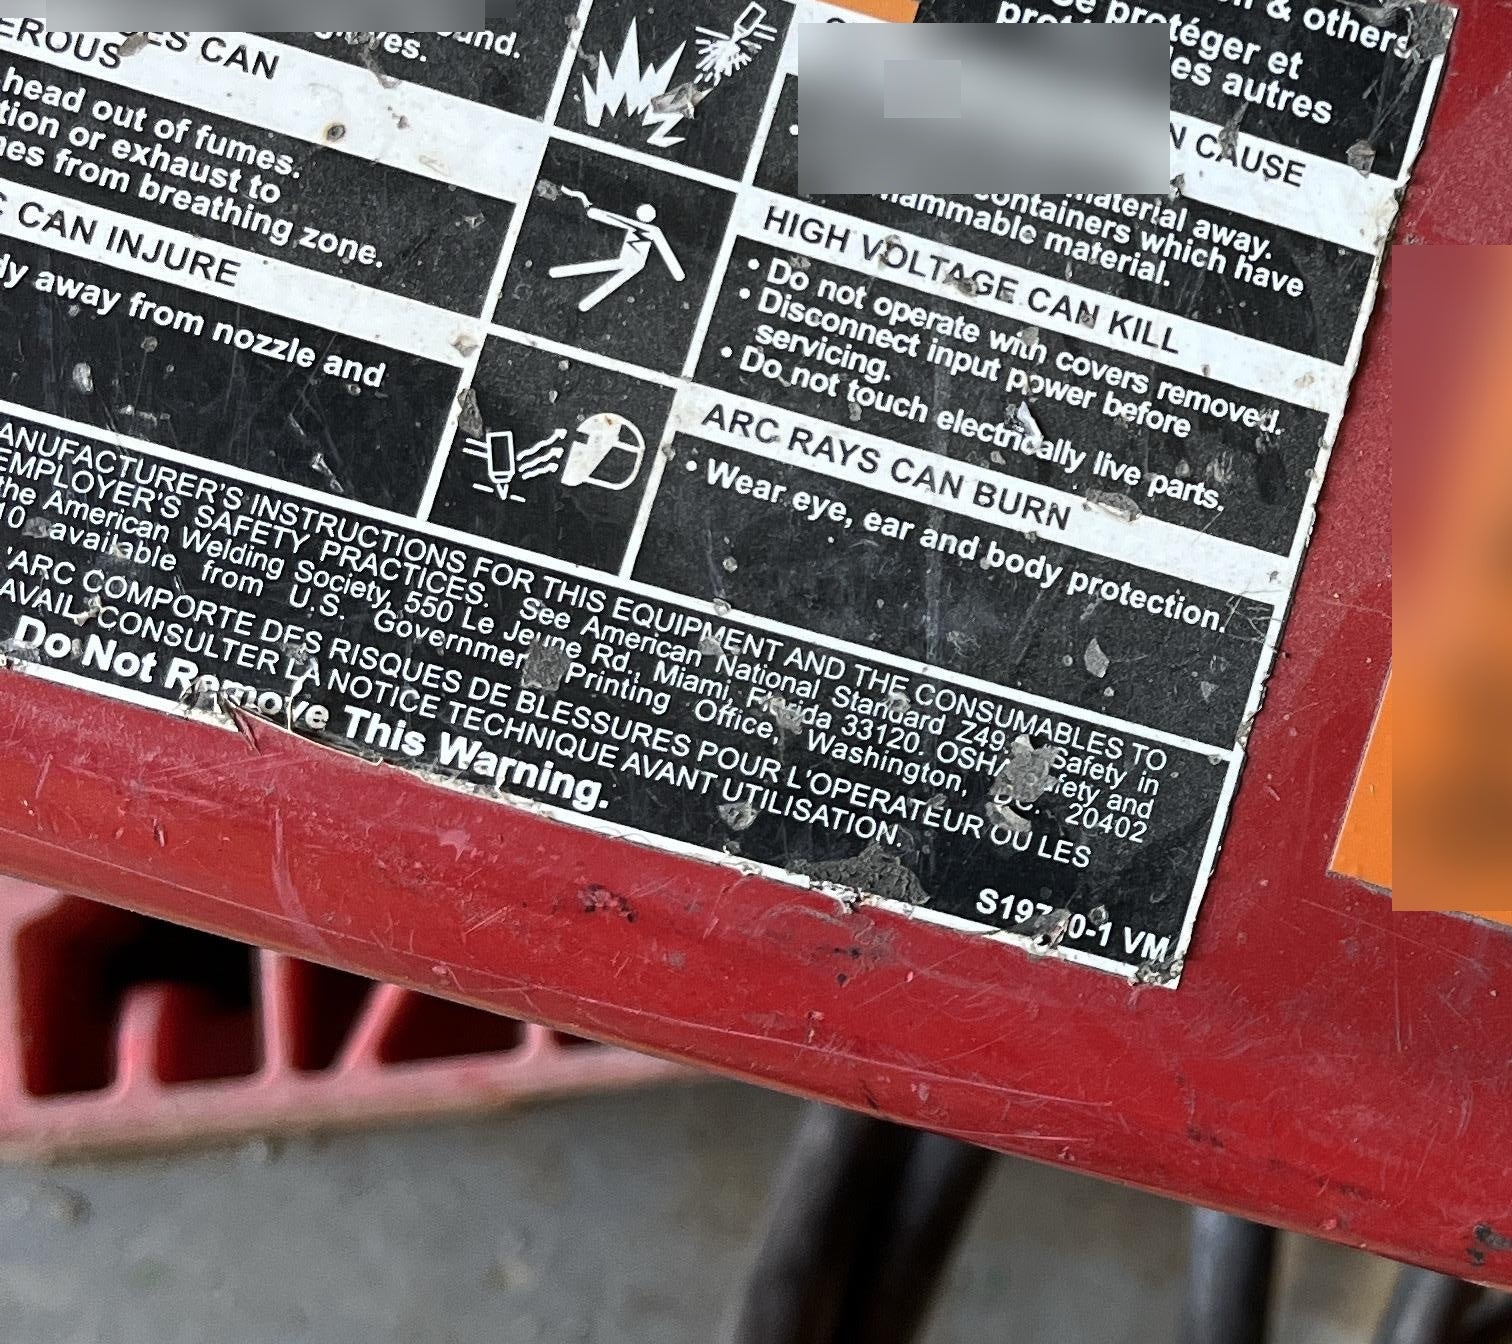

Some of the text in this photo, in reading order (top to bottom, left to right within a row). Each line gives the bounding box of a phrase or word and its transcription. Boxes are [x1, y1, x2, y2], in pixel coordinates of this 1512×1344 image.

[200, 36, 280, 80] CAN
[1221, 72, 1333, 125] autres
[1267, 51, 1304, 80] et
[1, 66, 302, 179] head out of fumes.
[68, 125, 281, 204] or exhaust to
[1195, 133, 1306, 188] CAUSE
[18, 201, 97, 245] CAN
[105, 226, 241, 287] INJURE
[53, 148, 383, 269] from breathing zone.
[1043, 231, 1170, 287] material.
[1141, 230, 1227, 275] which
[1233, 254, 1304, 298] have
[1186, 219, 1272, 262] away.
[34, 270, 386, 388] away from nozzle and
[763, 205, 1179, 354] HIGH VOLTAGE CAN KILL
[748, 324, 891, 384] servicing.
[757, 286, 1191, 438] Disconnect input power before
[766, 257, 1285, 438] Do not operate with covers removed.
[701, 403, 1071, 531] ARC RAYS CAN BURN
[739, 344, 1225, 519] Do not touch electrically live parts.
[707, 457, 1235, 634] Wear eye, ear and body protection.
[42, 489, 1155, 820] American Welding Society, 550 Le Miami, 33120. and
[46, 522, 177, 571] available
[201, 559, 268, 597] from
[289, 583, 345, 621] U.S.
[564, 660, 671, 715] Printing
[692, 698, 787, 745] Office,
[808, 728, 967, 798] Washington,
[1064, 802, 1148, 844] 20402
[193, 504, 1160, 796] SAFETY PRACTICES. See American National Standard in
[248, 493, 1167, 771] INSTRUCTIONS FOR THIS EQUIPMENT AND THE CONSUMABLES TO
[10, 614, 617, 822] Do Not This Warning.
[82, 569, 257, 637] COMPORTE
[328, 637, 463, 693] RISQUES
[467, 676, 512, 708] DE
[514, 689, 692, 757] BLESSURES
[696, 740, 782, 783] POUR
[786, 765, 985, 839] L'OPERATEUR
[990, 821, 1033, 852] OU
[1037, 835, 1092, 868] LES
[97, 603, 902, 848] CONSULTER LA NOTICE TECHNIQUE AVANT UTILISATION.
[975, 888, 1113, 947] S1970-1
